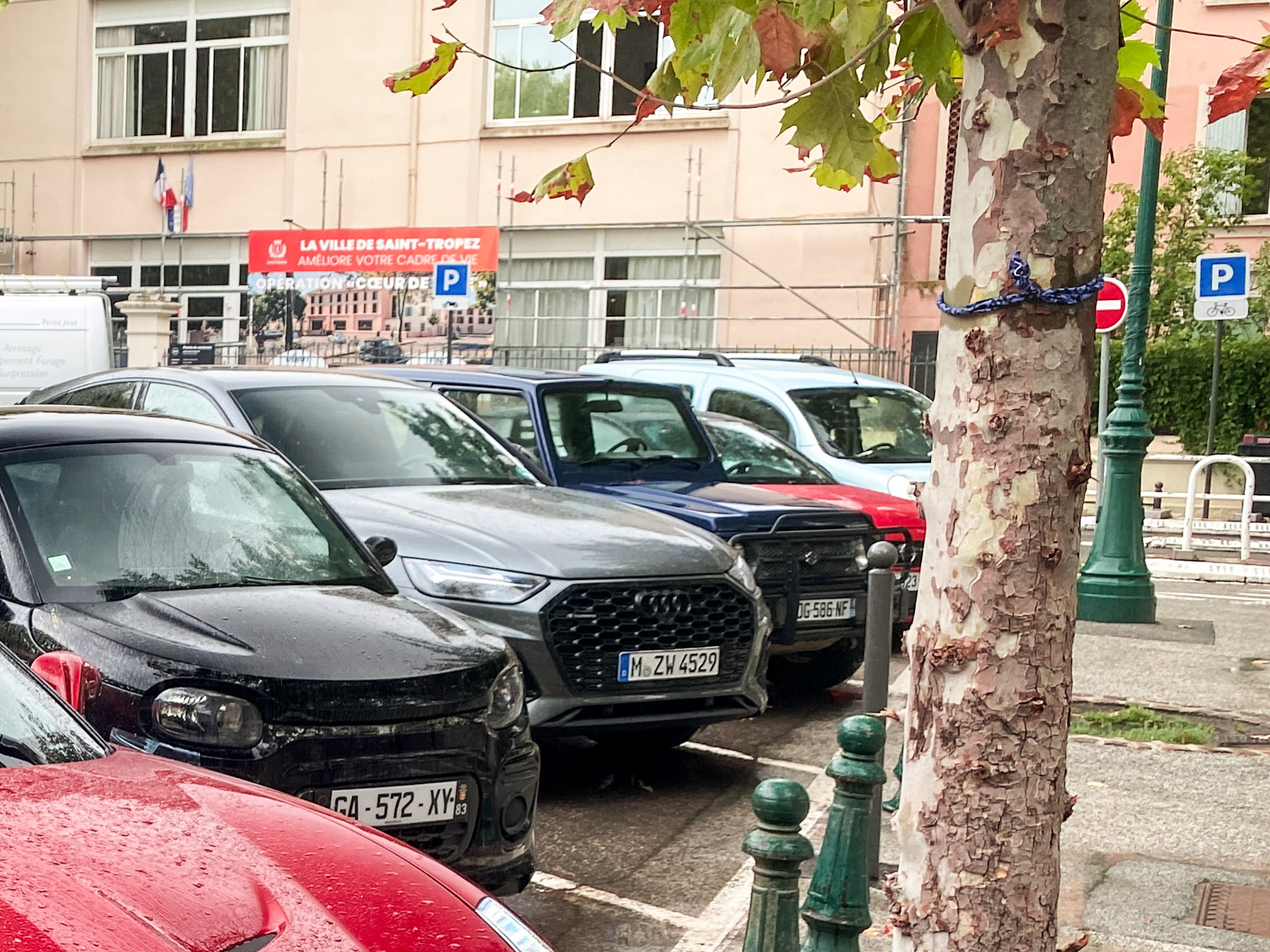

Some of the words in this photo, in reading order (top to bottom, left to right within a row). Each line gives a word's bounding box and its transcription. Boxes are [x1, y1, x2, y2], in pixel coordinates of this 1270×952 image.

[300, 239, 318, 251] LA
[319, 239, 356, 251] VILLE
[356, 239, 374, 251] DE
[375, 237, 481, 251] SAINT-TROPEZ
[298, 253, 352, 266] AMÉLIORE
[356, 254, 394, 266] VOTRE
[397, 253, 436, 266] CADRE
[256, 274, 344, 290] OPÉRATION
[408, 276, 429, 289] DE
[443, 269, 460, 291] P
[1211, 263, 1234, 291] P
[3, 343, 42, 354] Arrosage
[631, 656, 642, 678] M
[654, 655, 676, 675] ZW
[679, 652, 717, 674] 4529
[455, 803, 467, 815] 83
